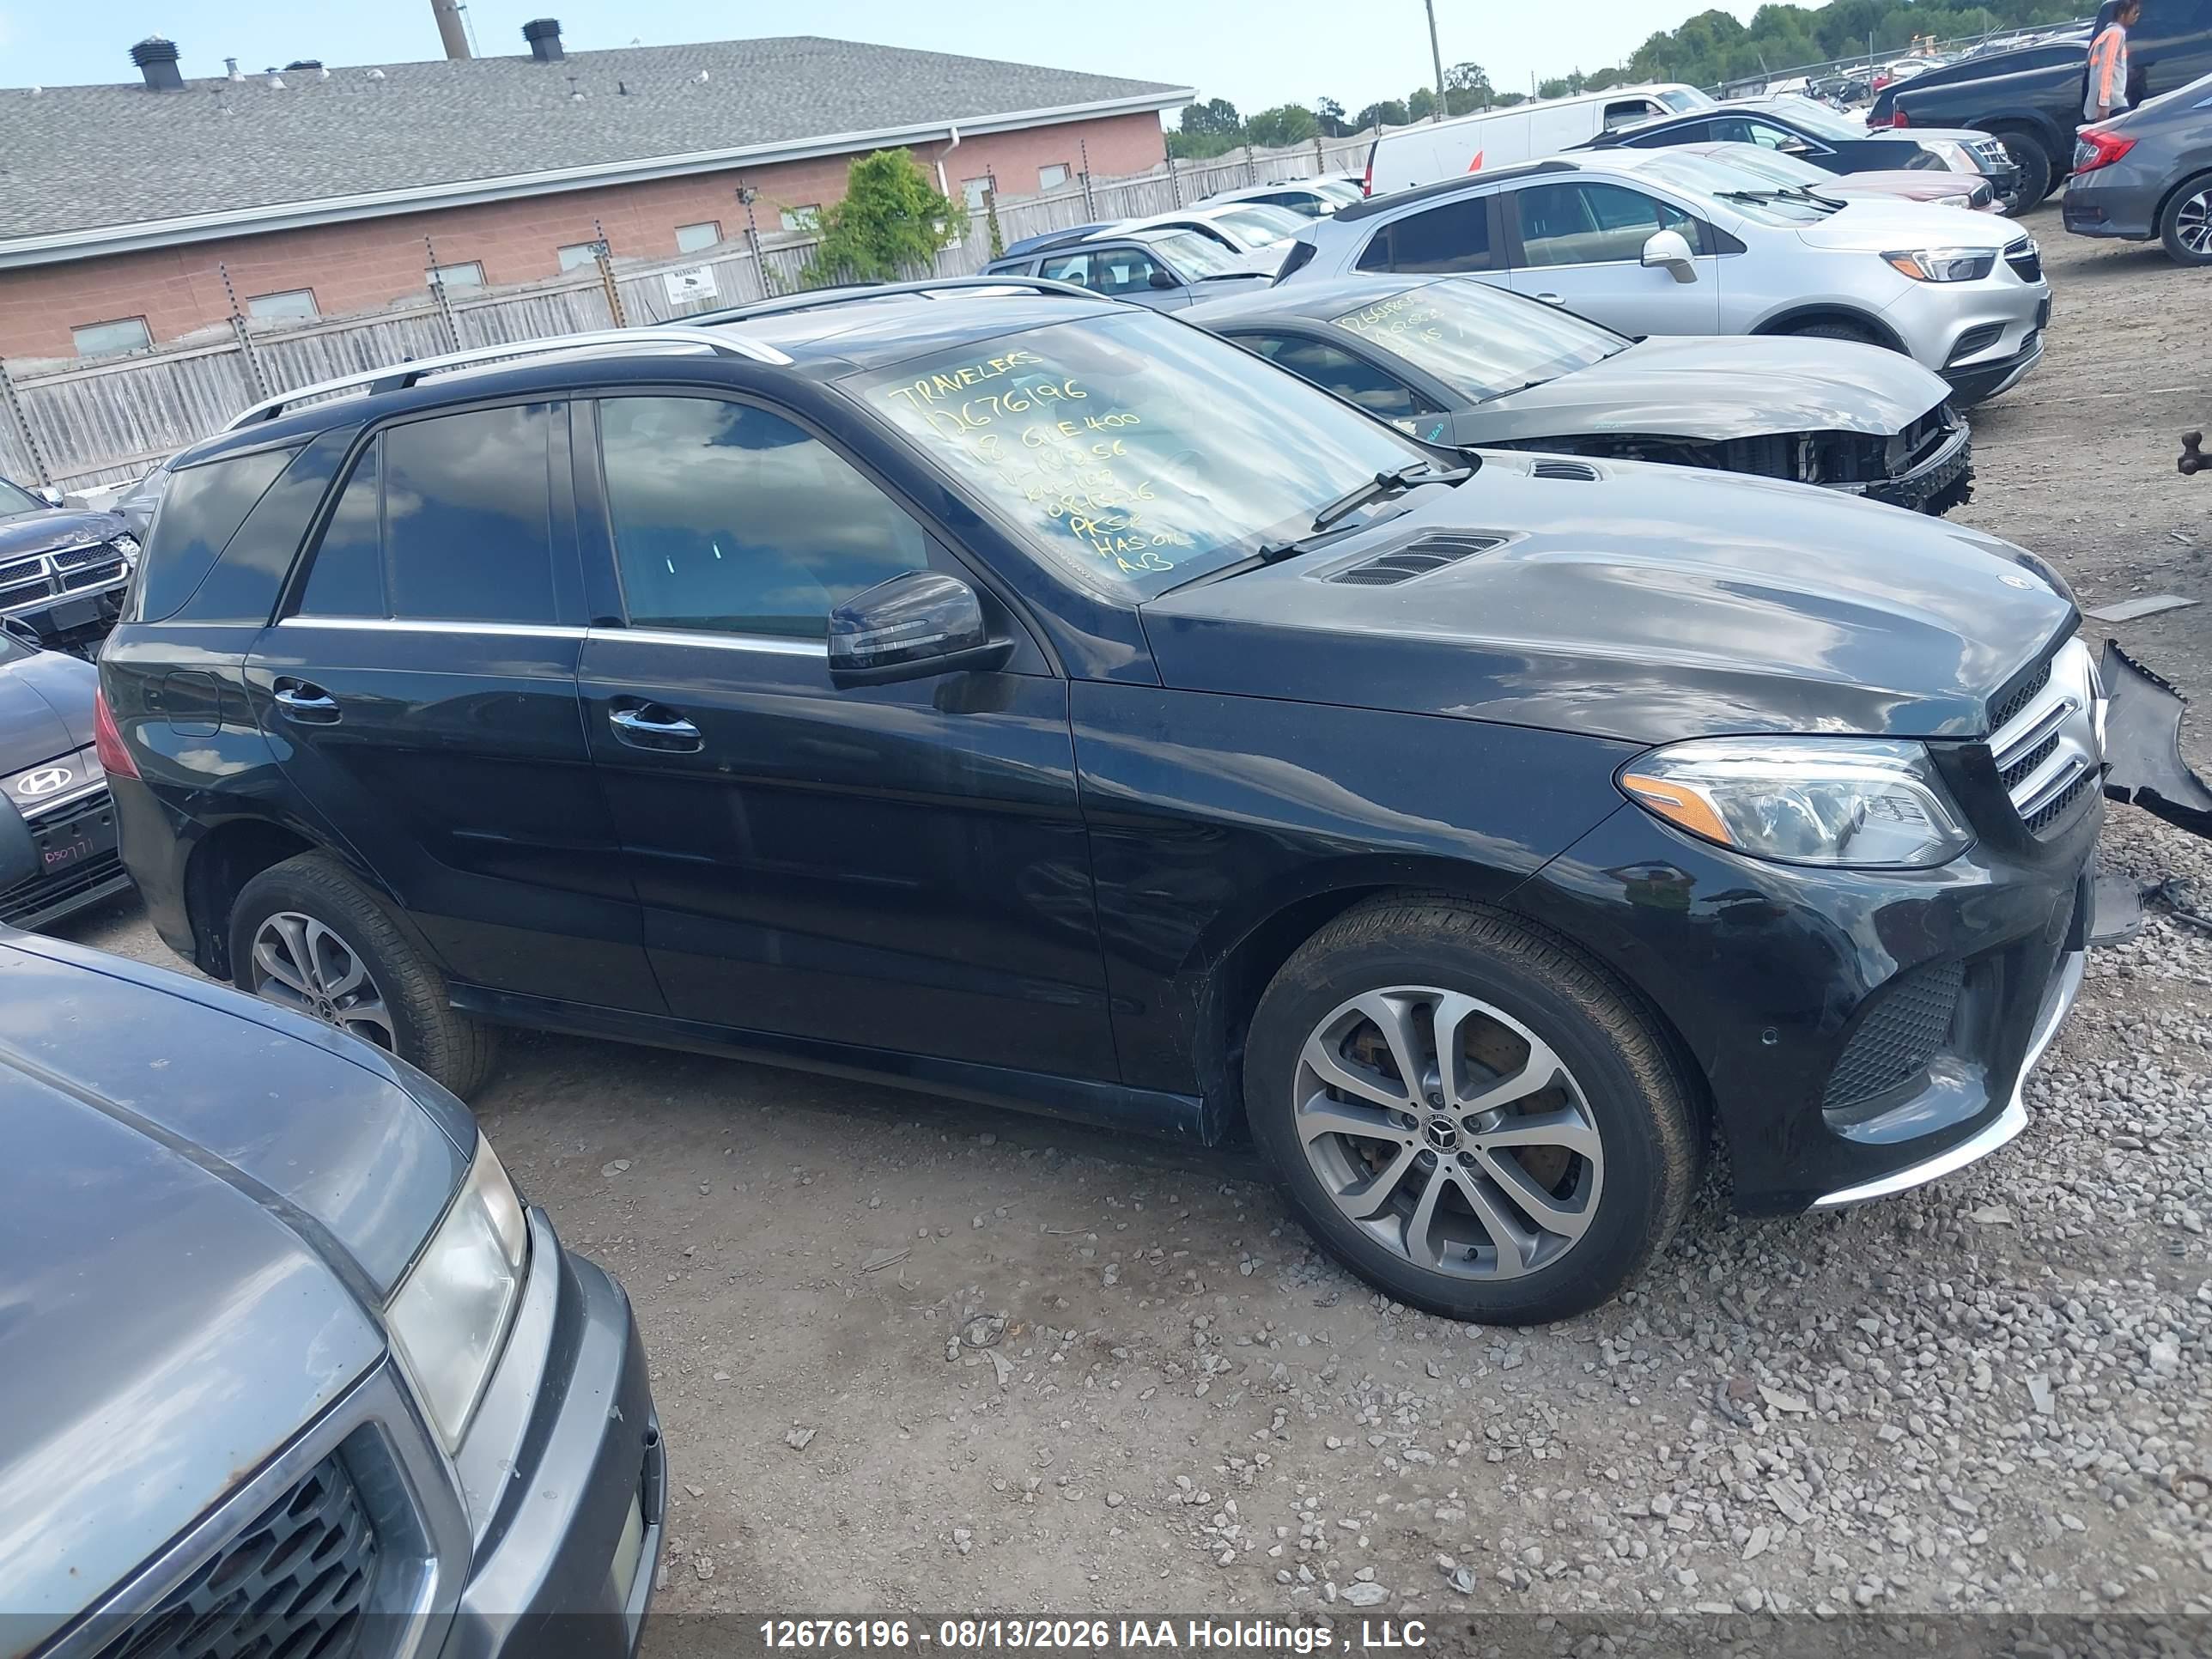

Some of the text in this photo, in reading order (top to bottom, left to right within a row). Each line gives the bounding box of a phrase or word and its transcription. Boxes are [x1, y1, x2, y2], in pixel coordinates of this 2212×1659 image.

[888, 351, 1044, 410] TRAVELERS
[922, 379, 1088, 441] 12676196
[967, 434, 1005, 465] 18
[1083, 413, 1141, 433] 400
[1091, 535, 1147, 559] HAS
